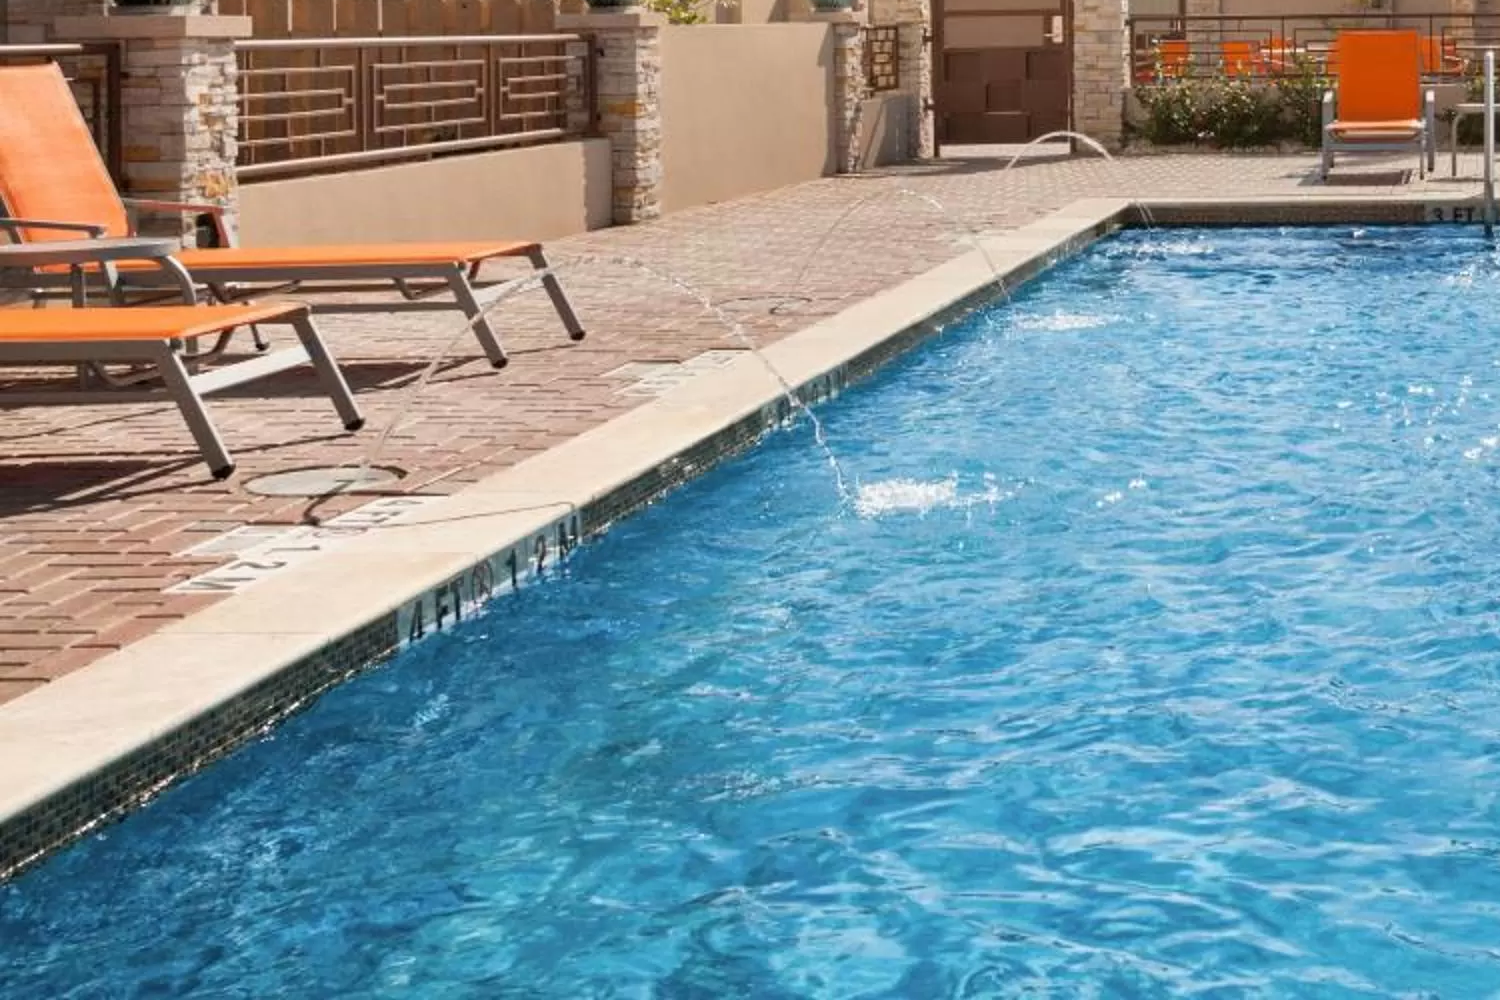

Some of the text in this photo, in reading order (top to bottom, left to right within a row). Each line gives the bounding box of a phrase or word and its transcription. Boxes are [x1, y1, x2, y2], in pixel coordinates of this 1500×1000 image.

[1453, 206, 1475, 223] FT
[435, 576, 465, 630] FT
[505, 548, 518, 588] 1
[559, 514, 578, 562] M
